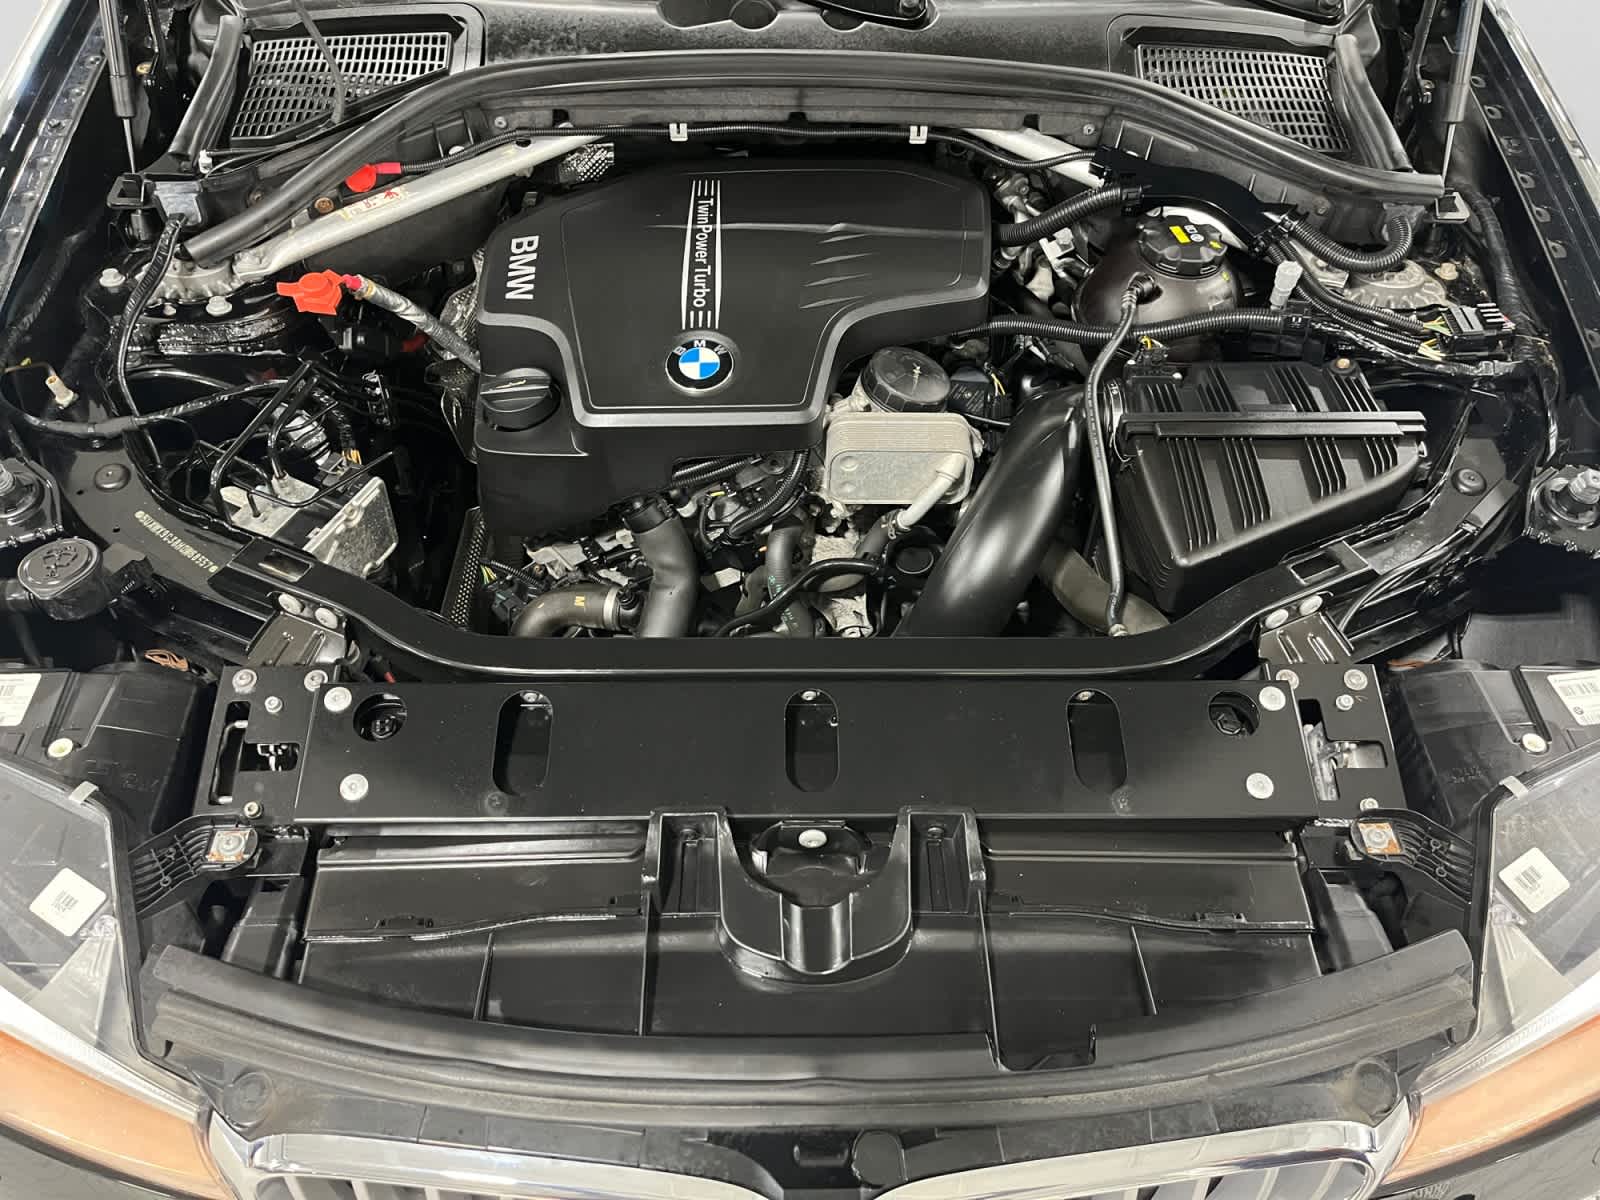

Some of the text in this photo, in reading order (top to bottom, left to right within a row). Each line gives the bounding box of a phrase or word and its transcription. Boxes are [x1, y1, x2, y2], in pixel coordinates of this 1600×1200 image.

[505, 235, 539, 300] BMW
[692, 197, 714, 308] TwinPower Turbo
[673, 339, 728, 356] BMW
